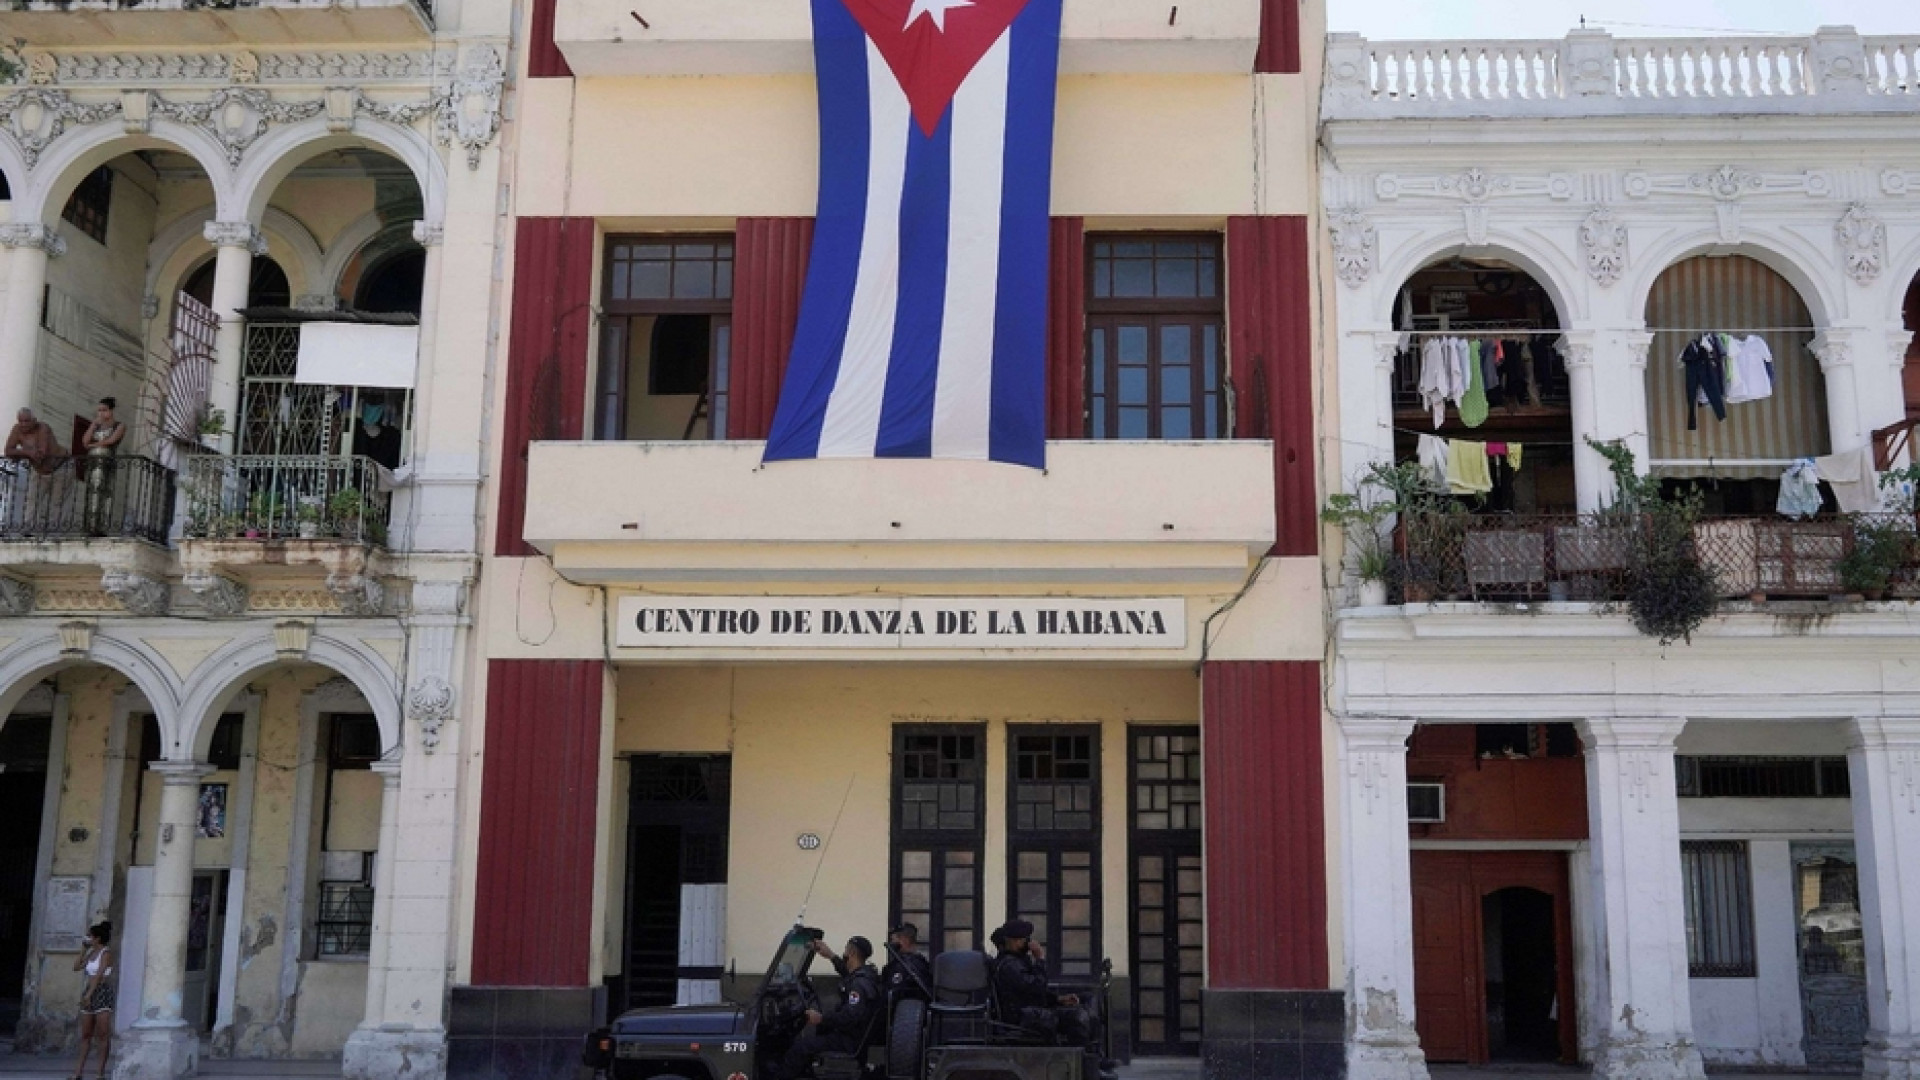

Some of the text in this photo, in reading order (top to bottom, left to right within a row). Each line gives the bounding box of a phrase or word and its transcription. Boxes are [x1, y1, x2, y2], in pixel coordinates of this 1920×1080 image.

[635, 607, 1168, 635] CENTRO DE DANZA DE LA HABANA
[723, 1041, 747, 1052] 570
